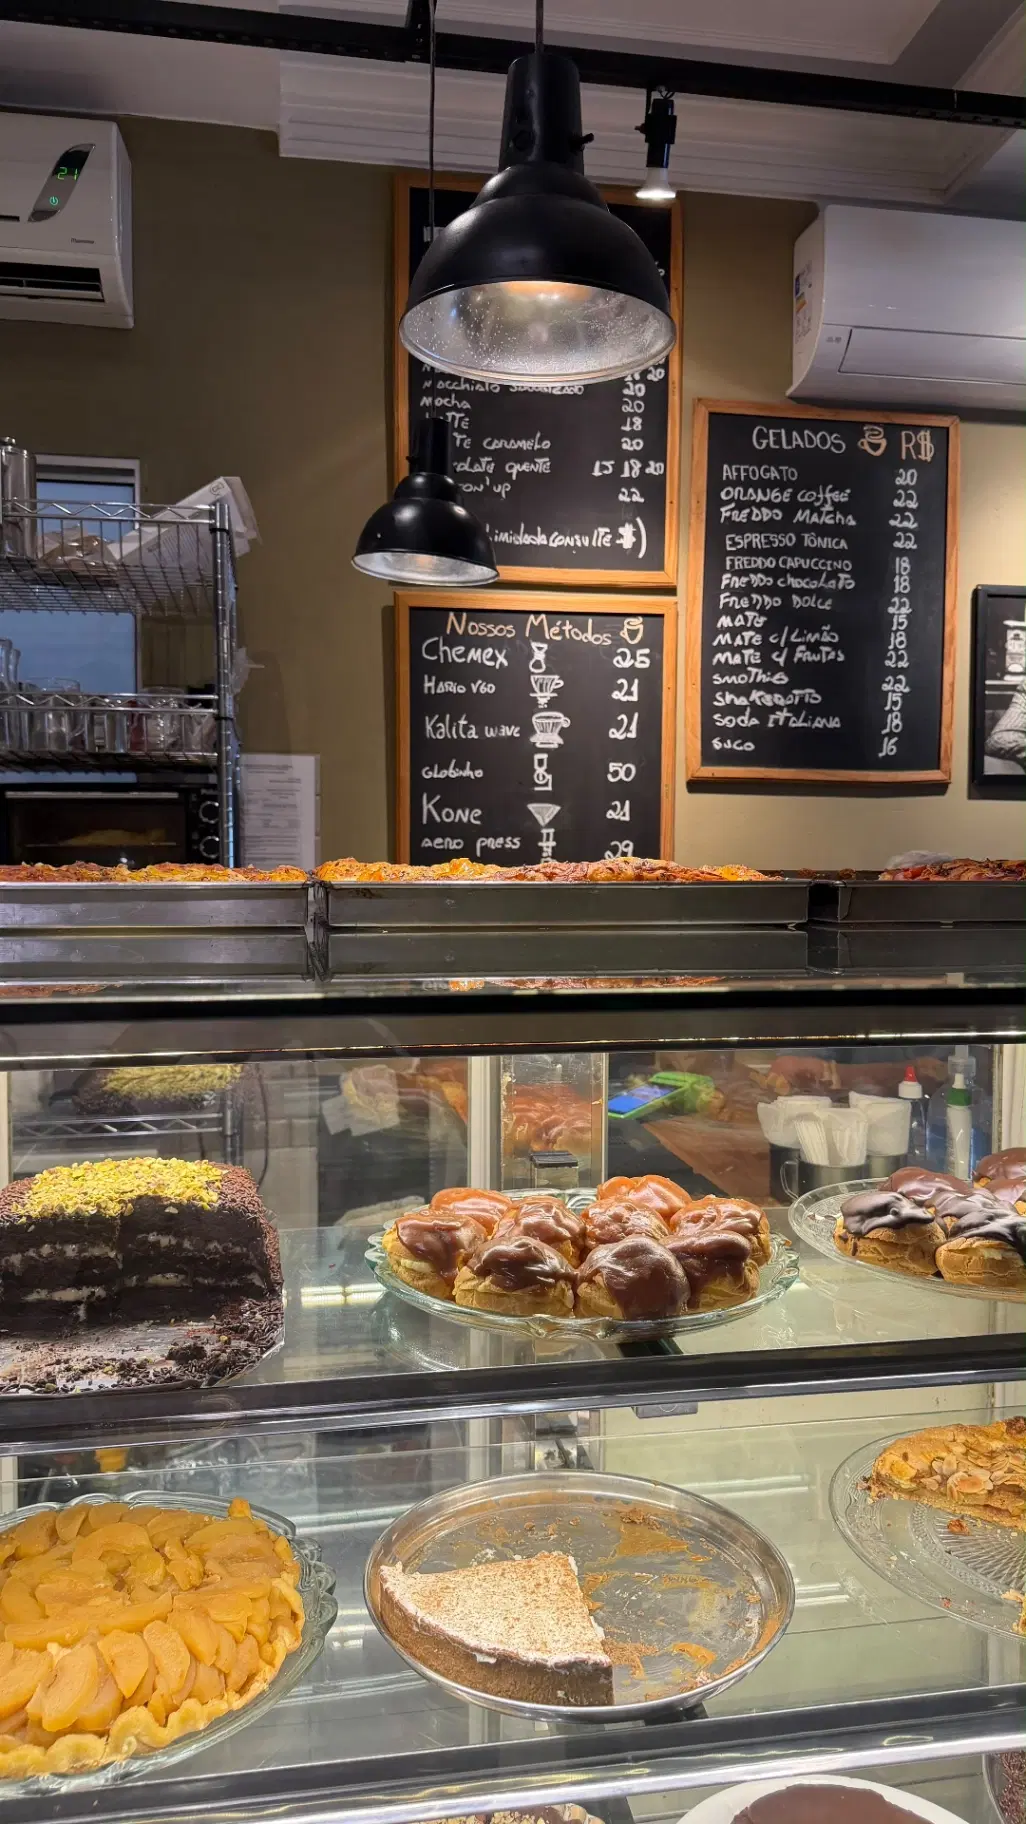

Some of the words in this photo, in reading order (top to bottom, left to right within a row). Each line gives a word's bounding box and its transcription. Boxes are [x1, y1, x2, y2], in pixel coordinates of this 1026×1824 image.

[57, 167, 79, 180] 21
[647, 367, 666, 381] 20
[621, 382, 646, 397] 20
[621, 398, 645, 413] 20
[621, 416, 643, 431] 18
[620, 438, 644, 451] 20
[752, 425, 846, 454] GELADOS
[901, 430, 935, 463] R$
[620, 460, 642, 478] 18
[645, 461, 665, 476] 20
[722, 464, 798, 481] AFFOGATO
[895, 468, 918, 486] 20
[618, 487, 645, 503] 22
[893, 489, 918, 510] 22
[889, 513, 918, 529] 22
[725, 532, 797, 551] ESPRESSO
[801, 532, 848, 550] TÔNICA
[893, 531, 918, 550] 22
[725, 556, 776, 571] FREDDO
[778, 556, 853, 572] CAPUCCINO
[895, 556, 911, 574] 18
[893, 574, 911, 594] 18
[887, 596, 913, 615] 22
[446, 612, 516, 636] Nossos
[525, 613, 612, 646] Métodos
[891, 614, 908, 632] 15
[888, 631, 907, 650] 18
[421, 636, 509, 669] Chemex
[613, 648, 651, 669] 25
[884, 650, 910, 669] 22
[611, 679, 639, 702] 21
[881, 674, 911, 693] 22
[884, 692, 903, 711] 15
[425, 713, 479, 740] Kalita
[608, 712, 639, 740] 21
[881, 711, 904, 736] 18
[878, 736, 899, 758] 16
[607, 762, 636, 782] 50
[606, 800, 631, 822] 21
[604, 839, 634, 860] 29
